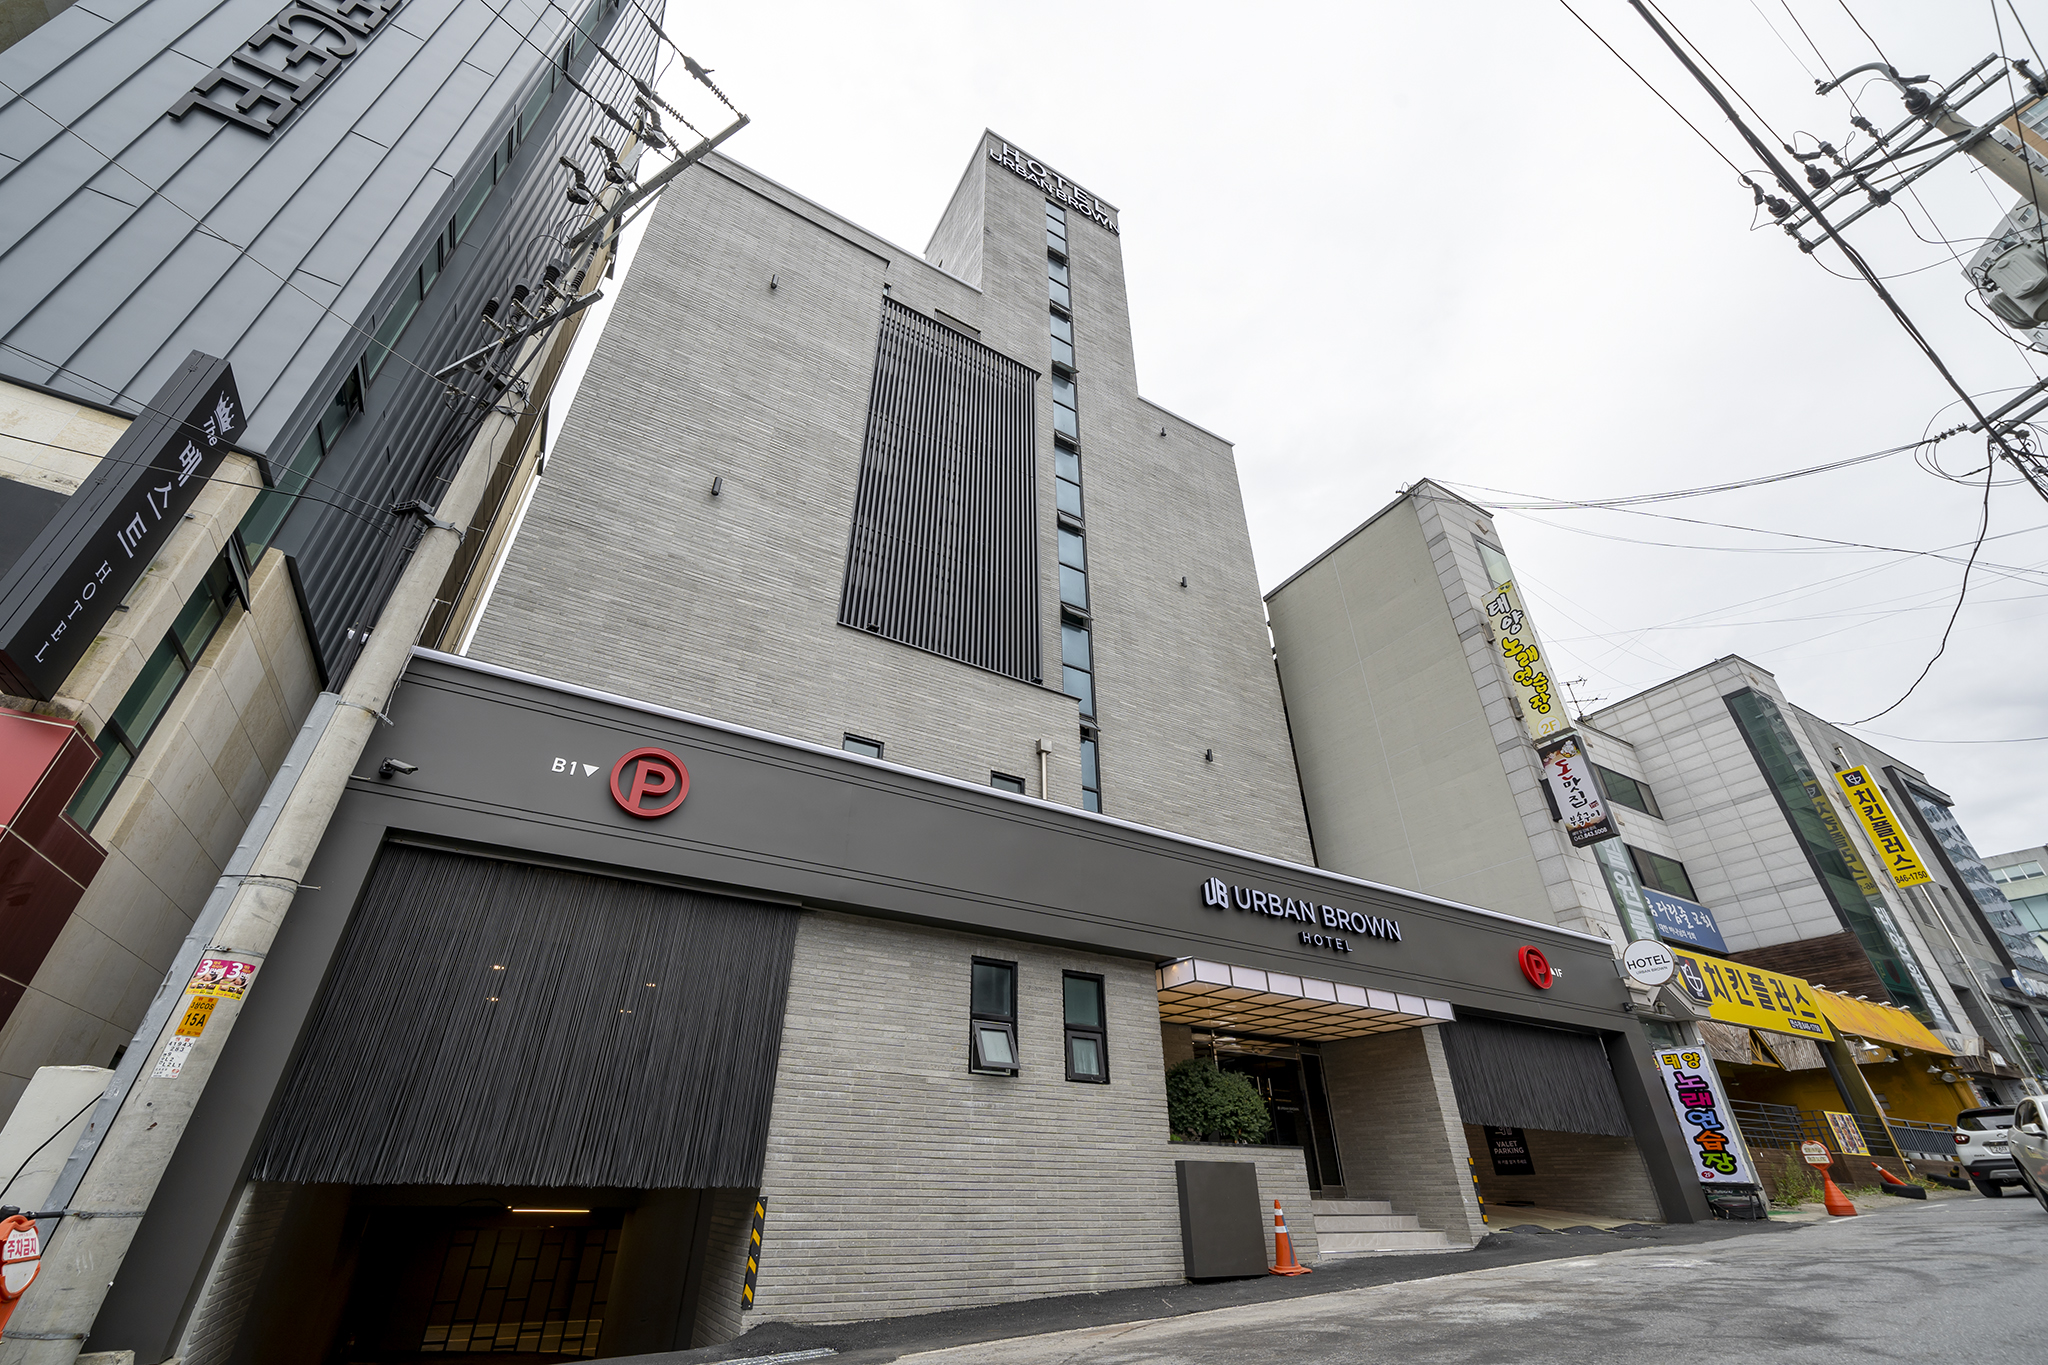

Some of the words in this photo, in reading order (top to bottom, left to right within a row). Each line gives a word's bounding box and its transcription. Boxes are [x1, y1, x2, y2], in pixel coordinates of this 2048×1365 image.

[989, 148, 1052, 195] URBAN
[1055, 186, 1121, 236] BROWN
[1003, 143, 1108, 217] HOTEL
[203, 416, 218, 446] The
[117, 440, 203, 558] 베스트
[34, 560, 112, 663] HOTEL
[1486, 592, 1524, 635] 태양
[1502, 637, 1551, 714] 노래연습장
[1541, 720, 1557, 734] 2F
[551, 757, 577, 776] B1
[1854, 787, 1916, 871] 치킨플러스
[1894, 871, 1928, 883] 846-1750
[1231, 885, 1316, 924] URBAN
[1319, 904, 1402, 942] BROWN
[1299, 931, 1353, 952] HOTEL
[1627, 955, 1670, 970] HOTEL
[1703, 961, 1816, 1019] 치킨플러스
[184, 1012, 206, 1027] 15A
[1661, 1052, 1701, 1070] 태양
[1673, 1071, 1738, 1175] 노래연습장
[7, 1237, 36, 1258] 주차금지
